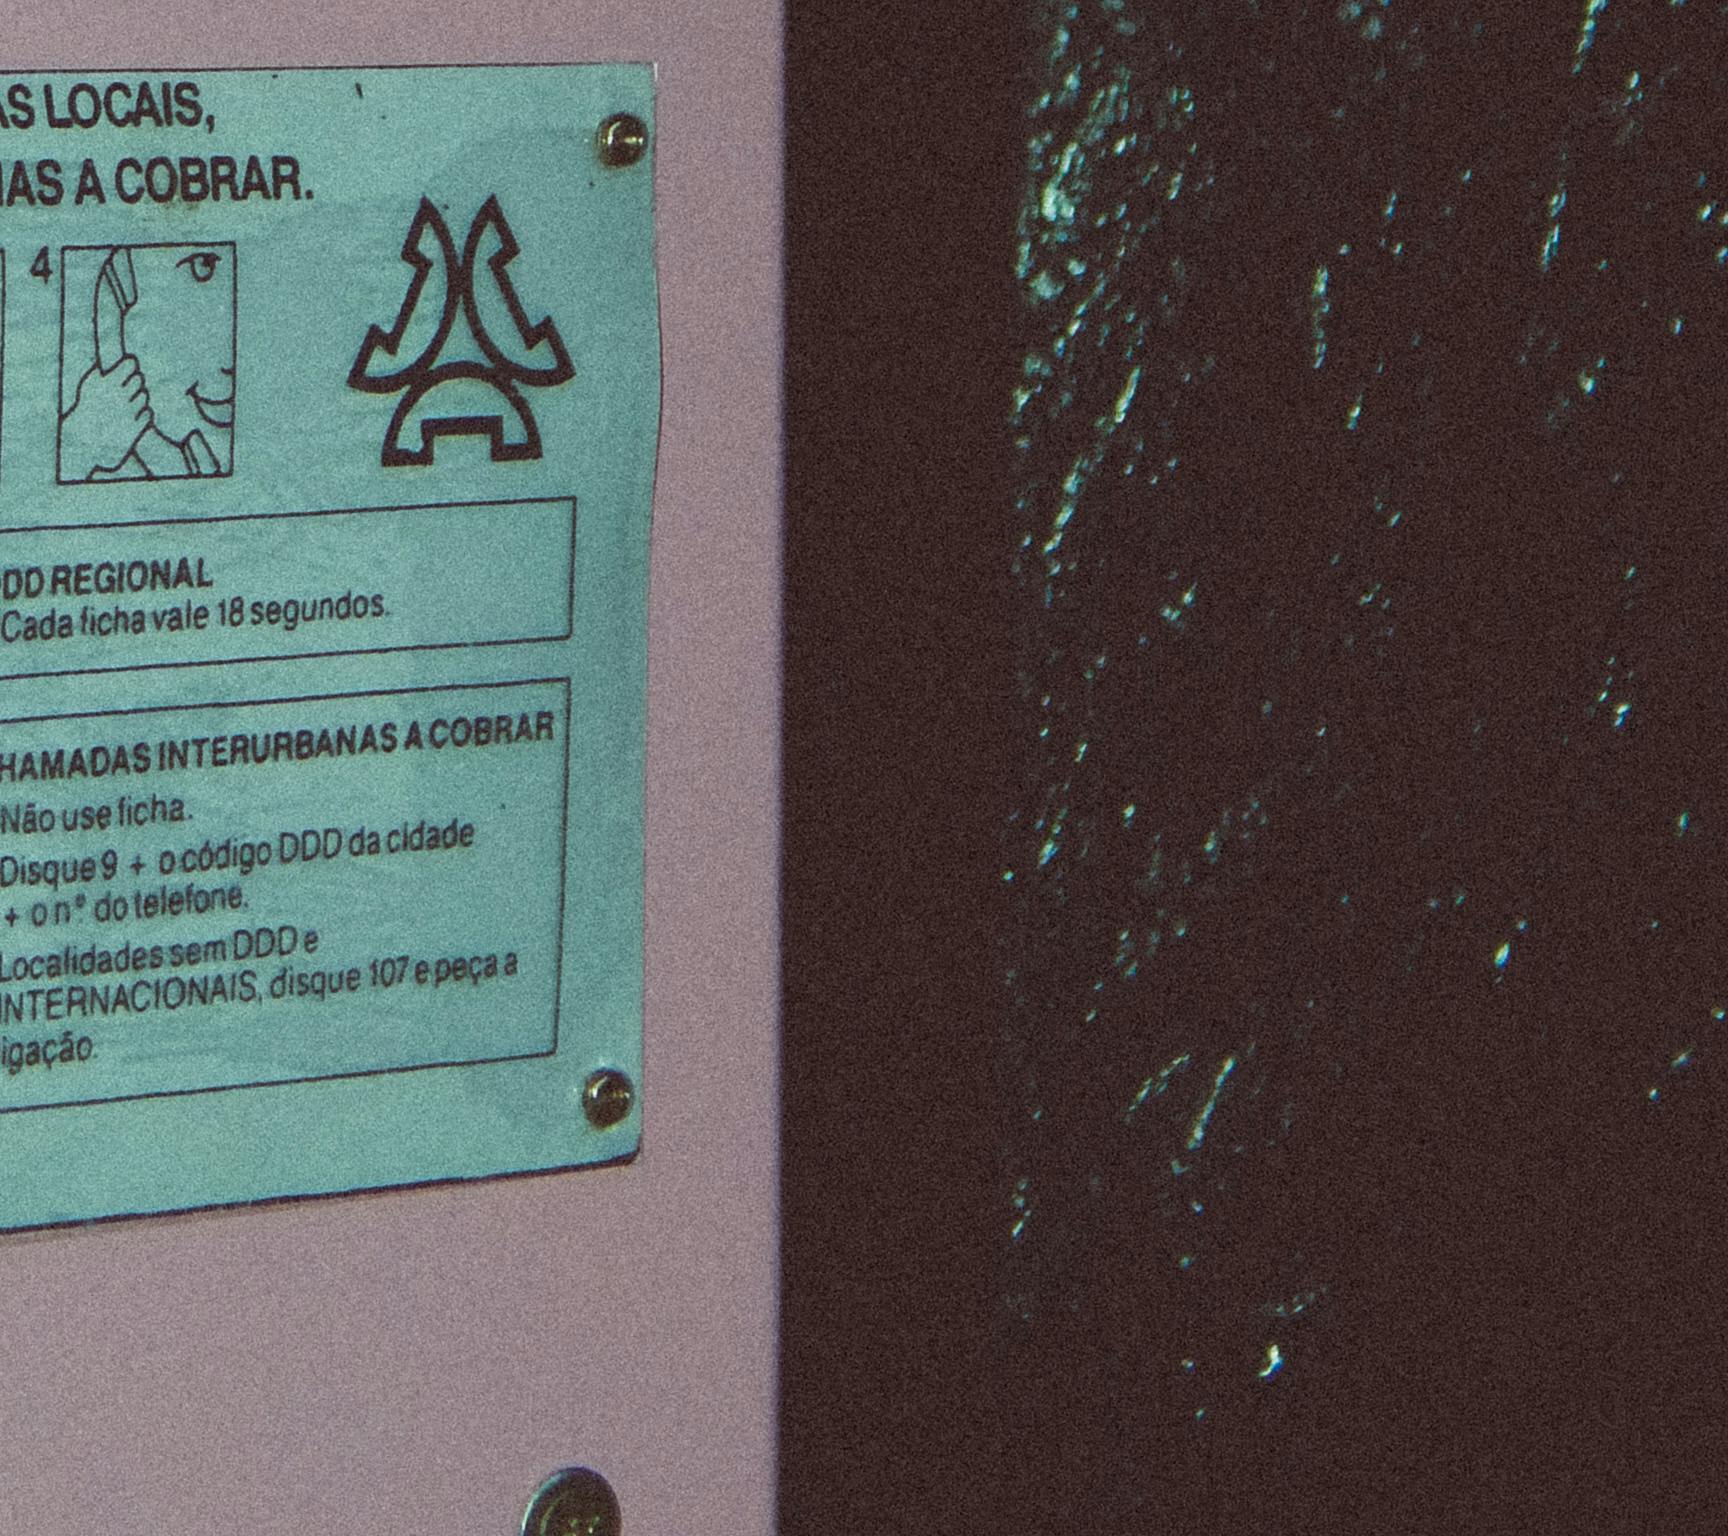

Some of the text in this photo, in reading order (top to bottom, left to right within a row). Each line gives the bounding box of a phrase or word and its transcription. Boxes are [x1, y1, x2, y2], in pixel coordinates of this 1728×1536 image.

[45, 81, 215, 134] LOCAIS,
[74, 160, 106, 206] A
[114, 156, 315, 205] COBRAR.
[30, 246, 53, 282] 4
[51, 556, 214, 598] REGIONAL
[0, 591, 391, 644] Cada ficha vale 18 segundos.
[157, 720, 398, 774] INTERURBANAS
[405, 719, 423, 748] A
[429, 711, 555, 747] COBRAR
[0, 795, 193, 834] Não use ficha.
[0, 855, 97, 891] Disque
[100, 851, 117, 878] 9
[159, 851, 174, 875] o
[180, 836, 272, 879] código
[280, 829, 342, 865] DDD
[349, 828, 382, 858] da
[387, 818, 475, 854] cidade
[30, 904, 48, 926] o
[95, 893, 130, 922] do
[133, 885, 249, 918] telefone.
[169, 938, 230, 969] sem
[233, 926, 299, 961] DDD
[304, 930, 318, 955] e
[269, 964, 360, 1005] disque
[370, 956, 408, 988] 107
[414, 962, 429, 985] e
[433, 956, 499, 988] peça
[503, 950, 519, 975] a
